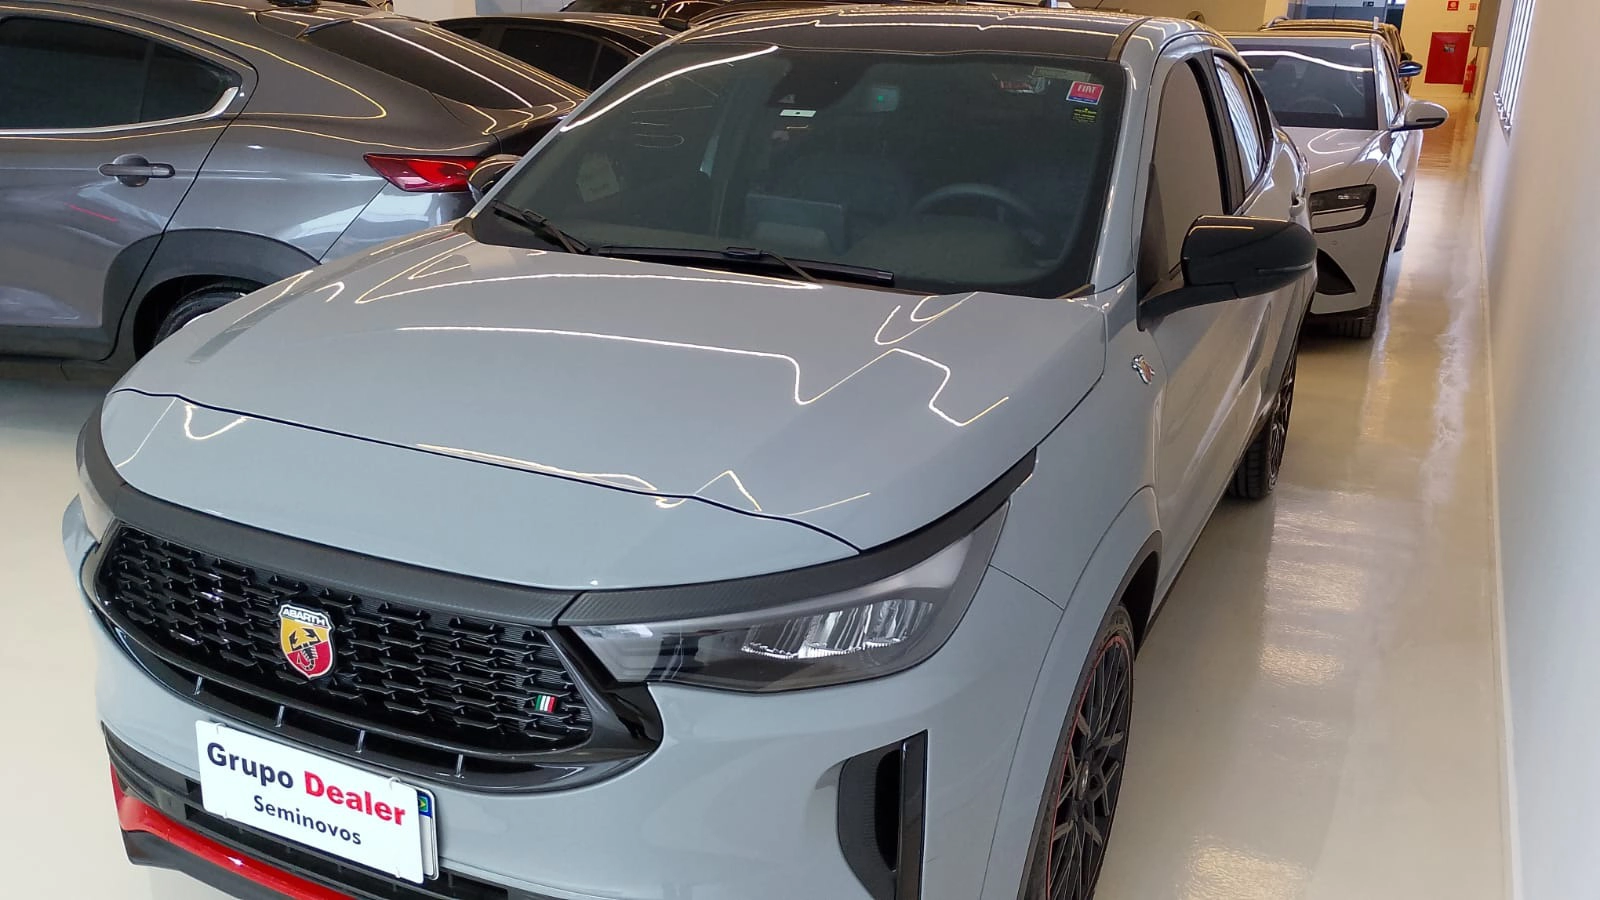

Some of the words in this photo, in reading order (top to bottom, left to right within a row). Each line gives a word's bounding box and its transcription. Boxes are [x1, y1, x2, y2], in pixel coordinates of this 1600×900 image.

[1077, 84, 1096, 94] FIAT
[283, 608, 327, 626] ABARTH
[207, 742, 294, 788] Grupo
[304, 770, 406, 825] Dealer
[254, 795, 362, 845] Seminovos
